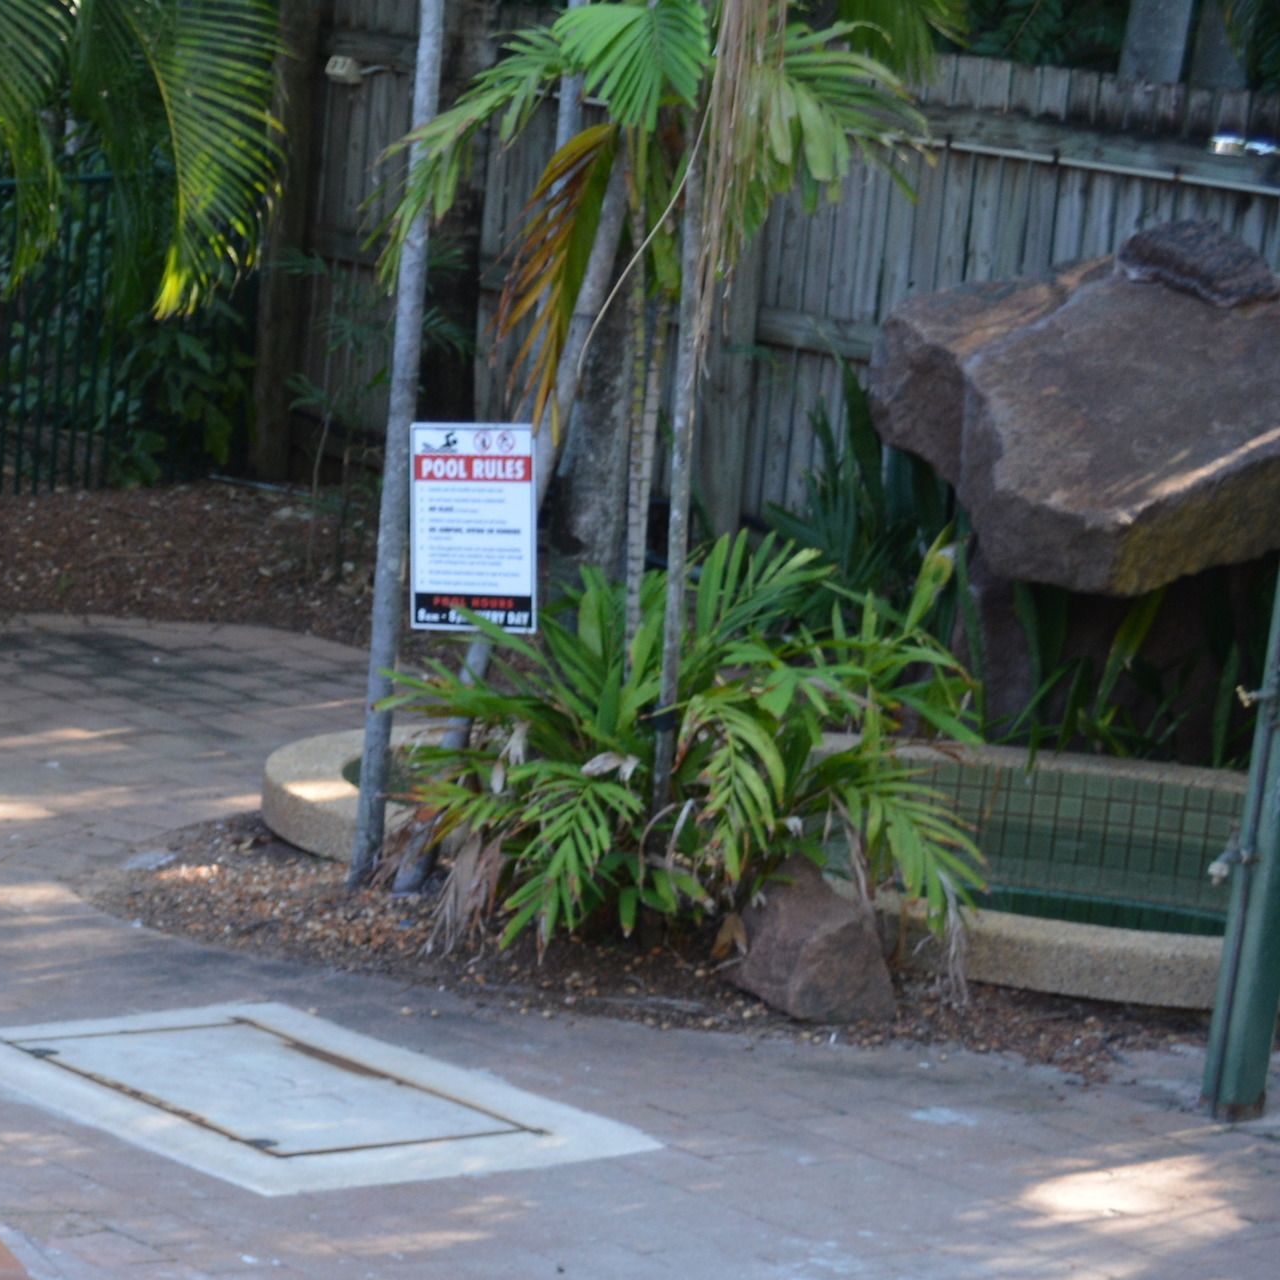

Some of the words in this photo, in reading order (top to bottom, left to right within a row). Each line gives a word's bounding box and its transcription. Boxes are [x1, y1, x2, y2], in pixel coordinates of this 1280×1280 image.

[422, 458, 467, 478] POOL
[473, 458, 525, 479] RULES
[433, 596, 465, 607] POOL
[472, 598, 514, 608] HOURS
[507, 611, 529, 625] DAY
